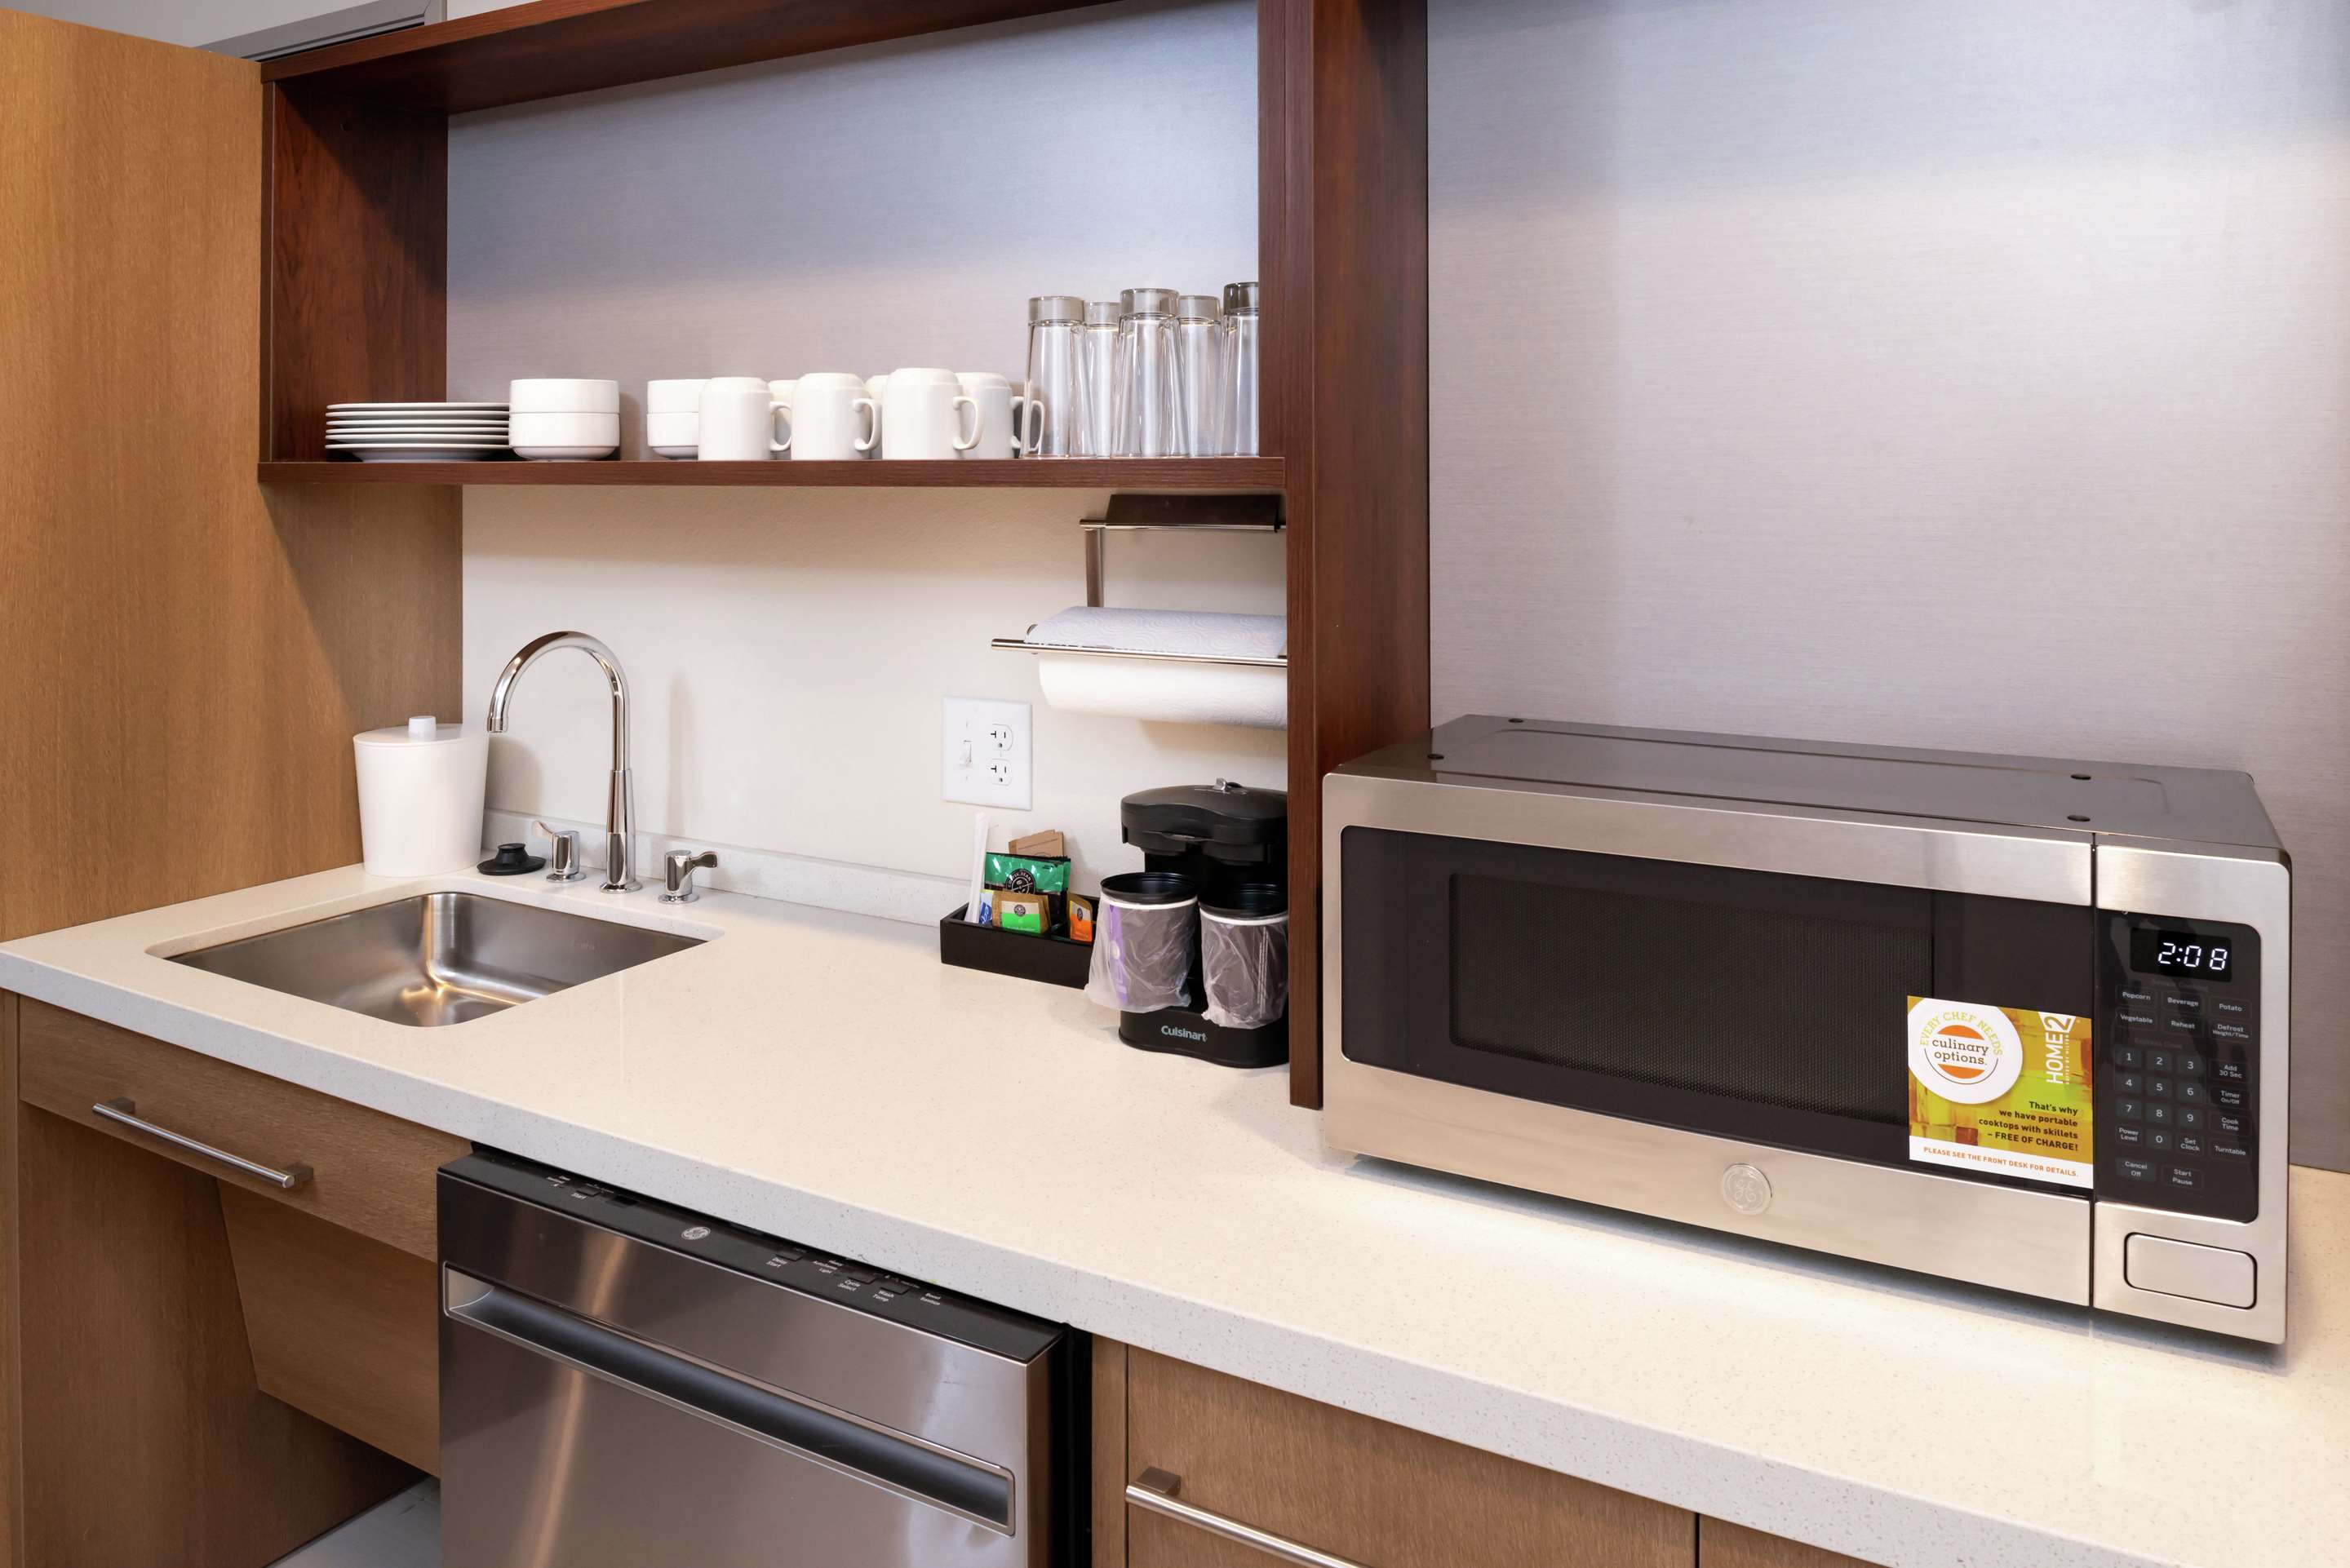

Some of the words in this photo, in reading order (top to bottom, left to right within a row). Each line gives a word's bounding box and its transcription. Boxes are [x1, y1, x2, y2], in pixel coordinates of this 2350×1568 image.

[2157, 941, 2228, 971] 2:08
[2122, 991, 2151, 1001] Popcorn
[2167, 997, 2199, 1007] Beverage
[2219, 1003, 2243, 1012] Potato
[2120, 1014, 2153, 1024] Vegetable
[2170, 1021, 2195, 1030] Reheat
[2217, 1023, 2244, 1033] Defrost
[1160, 1025, 1208, 1043] Cuisinart
[1920, 1016, 1940, 1046] EVERY
[1943, 1012, 1976, 1023] CHEF
[1976, 1020, 2003, 1056] NEEDS
[1932, 1039, 1989, 1056] culinary
[2126, 1052, 2131, 1061] 1
[2156, 1057, 2163, 1065] 2
[2187, 1061, 2194, 1070] 3
[2125, 1079, 2132, 1087] 4
[2156, 1083, 2163, 1092] 5
[2187, 1087, 2194, 1096] 6
[2220, 1090, 2240, 1099] Timer
[2029, 1101, 2056, 1112] That's
[2059, 1106, 2078, 1116] why
[2126, 1105, 2132, 1113] 7
[2015, 1110, 2037, 1121] have
[2038, 1114, 2078, 1127] portable
[2156, 1110, 2163, 1118] 8
[2187, 1114, 2194, 1123] 9
[2221, 1117, 2239, 1125] Cook
[1979, 1118, 2020, 1131] cooktops
[2021, 1125, 2042, 1134] with
[2043, 1127, 2078, 1139] skillets
[2119, 1127, 2139, 1136] Power
[2222, 1123, 2239, 1132] Time
[1995, 1132, 2020, 1142] FREE
[2021, 1136, 2034, 1144] OF
[2036, 1137, 2079, 1152] CHARGE!
[2120, 1134, 2138, 1142] Level
[2184, 1137, 2197, 1145] Set
[2180, 1143, 2201, 1151] Clock
[2215, 1145, 2246, 1156] Turntable
[1923, 1146, 1951, 1157] PLEASE
[1967, 1154, 1982, 1162] THE
[1983, 1156, 2006, 1166] FRONT
[2009, 1161, 2028, 1169] DESK
[2046, 1167, 2080, 1178] DETAILS.
[2125, 1161, 2148, 1170] Cancel
[2174, 1168, 2192, 1177] Start
[2172, 1176, 2193, 1186] Pause
